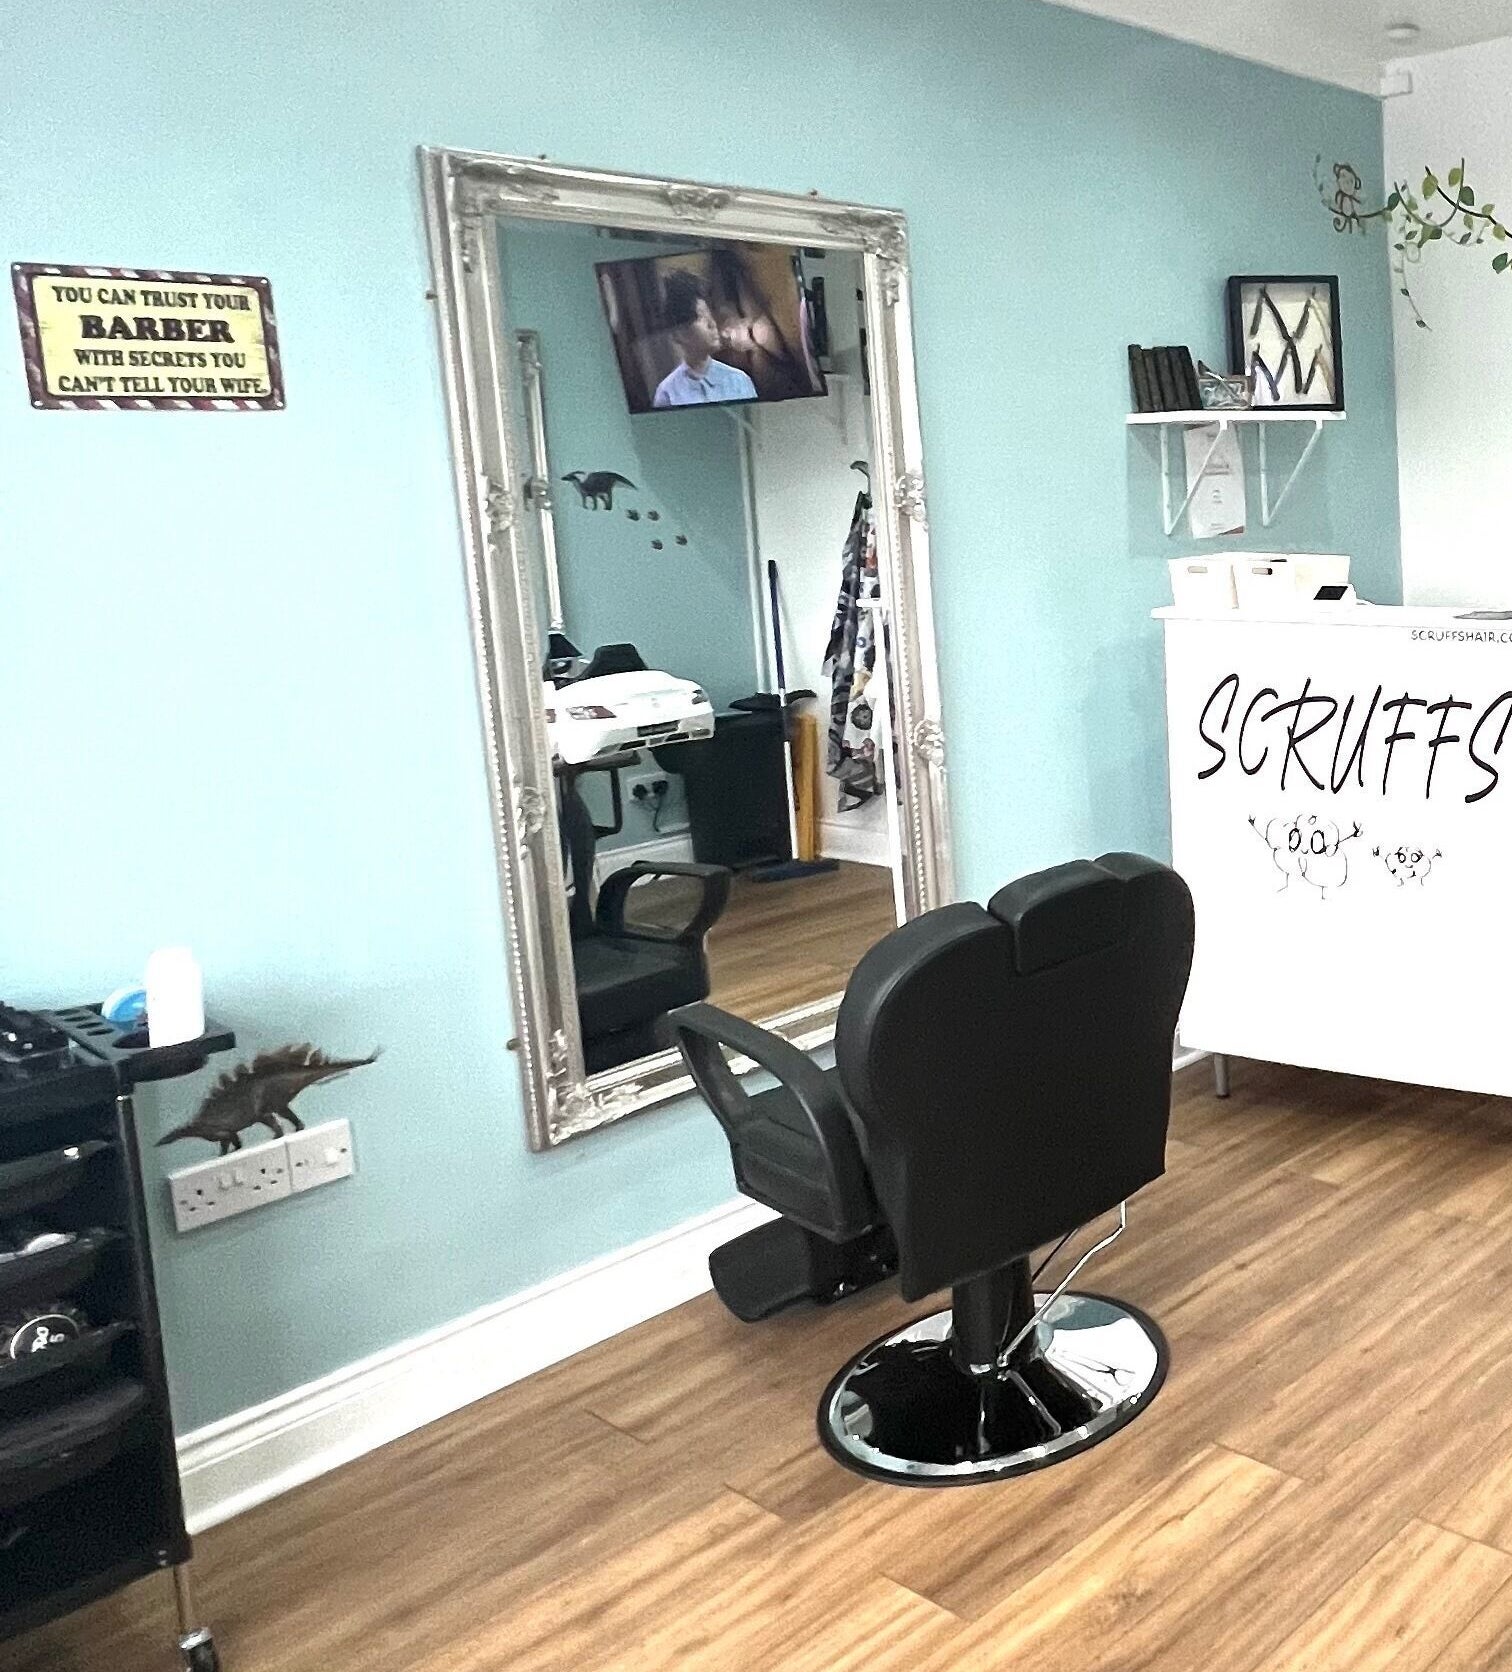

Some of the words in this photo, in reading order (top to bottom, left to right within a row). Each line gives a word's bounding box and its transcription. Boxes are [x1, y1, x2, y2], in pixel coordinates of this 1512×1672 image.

[52, 286, 92, 304] YOU
[97, 288, 136, 306] CAN
[141, 290, 199, 309] TRUST
[203, 293, 251, 311] YOUR
[80, 314, 235, 343] BARBER
[74, 349, 124, 366] WITH
[129, 350, 208, 368] SECRETS
[210, 353, 246, 369] YOU
[58, 375, 115, 393] CAN'T
[119, 376, 164, 393] TELL
[168, 377, 217, 393] YOUR
[221, 378, 267, 394] WIFE.
